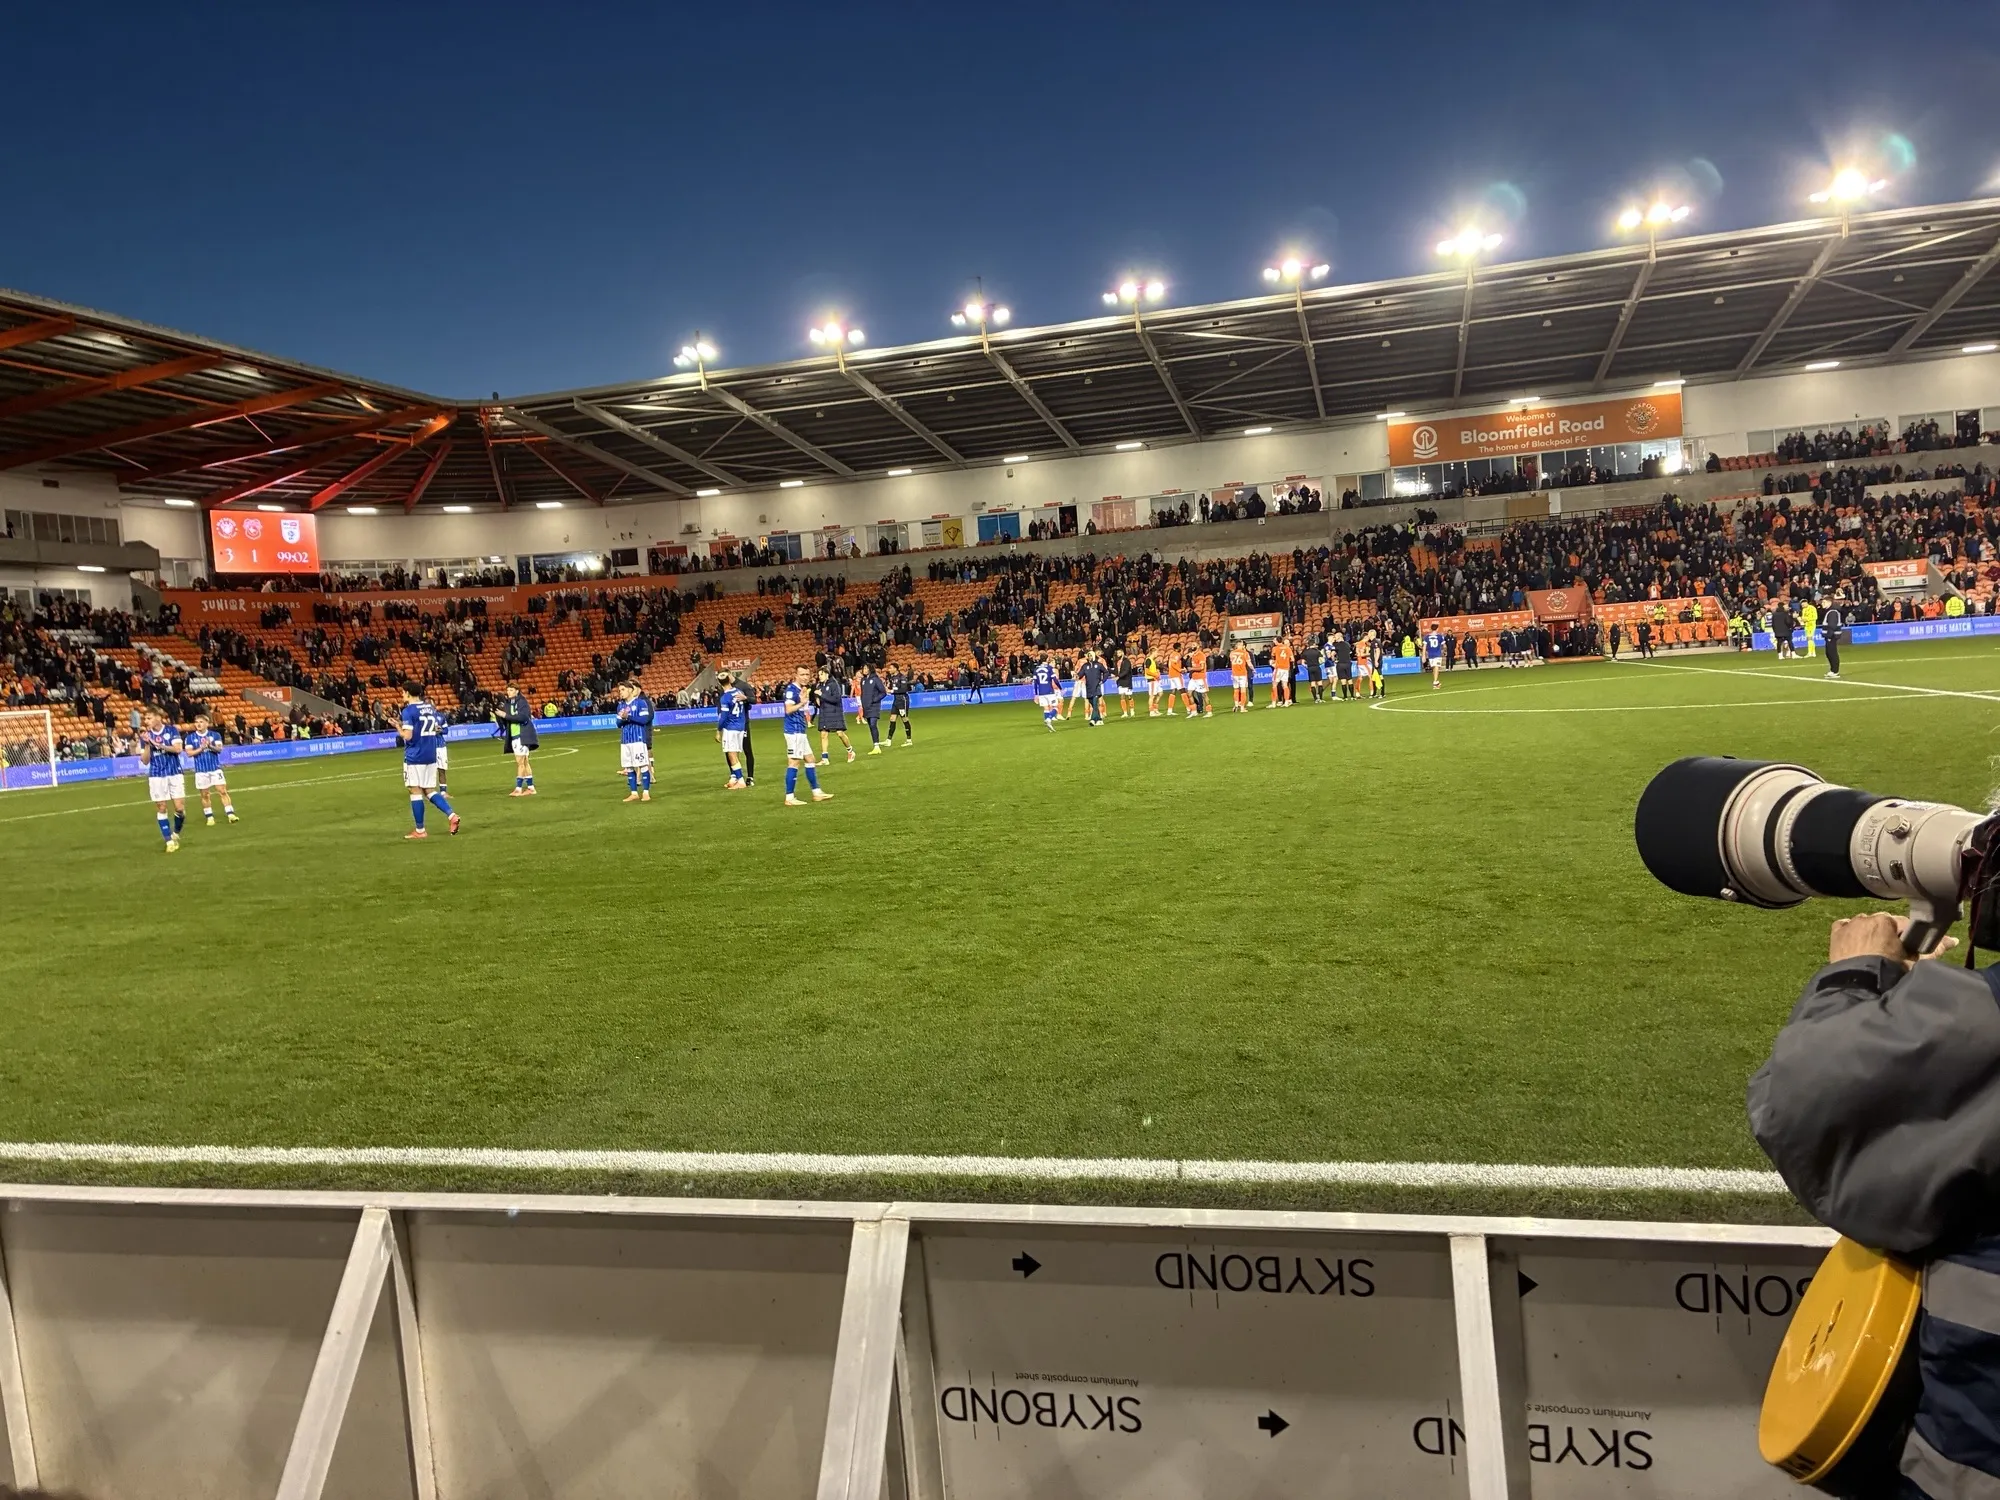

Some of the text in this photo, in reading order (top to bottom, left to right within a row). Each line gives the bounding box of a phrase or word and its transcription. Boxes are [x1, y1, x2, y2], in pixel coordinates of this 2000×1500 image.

[1625, 402, 1658, 418] BLACKPOOL
[1505, 411, 1556, 423] Welcome to
[1460, 415, 1605, 444] Bloomfield Road
[1478, 435, 1587, 454] The home of Blackpool FC
[224, 547, 234, 564] 3
[252, 549, 258, 563] 1
[277, 551, 309, 563] 99:02
[1873, 563, 1919, 575] LINKS
[594, 585, 647, 597] SASIDERS
[200, 598, 247, 612] JUNIOR
[419, 597, 447, 606] TOWER
[1236, 616, 1273, 627] LINKS
[1909, 625, 1925, 636] MAN
[1925, 624, 1934, 634] OF
[1935, 623, 1947, 634] THE
[1948, 622, 1972, 633] MATCH
[1429, 638, 1438, 648] 10
[1231, 655, 1243, 665] 26
[1280, 650, 1287, 660] 4
[720, 659, 751, 668] LINKS
[1037, 673, 1048, 684] 12
[418, 715, 436, 736] 22
[591, 718, 601, 727] MAN
[634, 752, 645, 760] 45
[1155, 1252, 1375, 1297] SKYBOND
[1015, 1371, 1139, 1388] Aluminium composite sheet
[940, 1386, 1142, 1433] SKYBOND
[1535, 1403, 1591, 1416] composite
[1594, 1409, 1652, 1421] Aluminium
